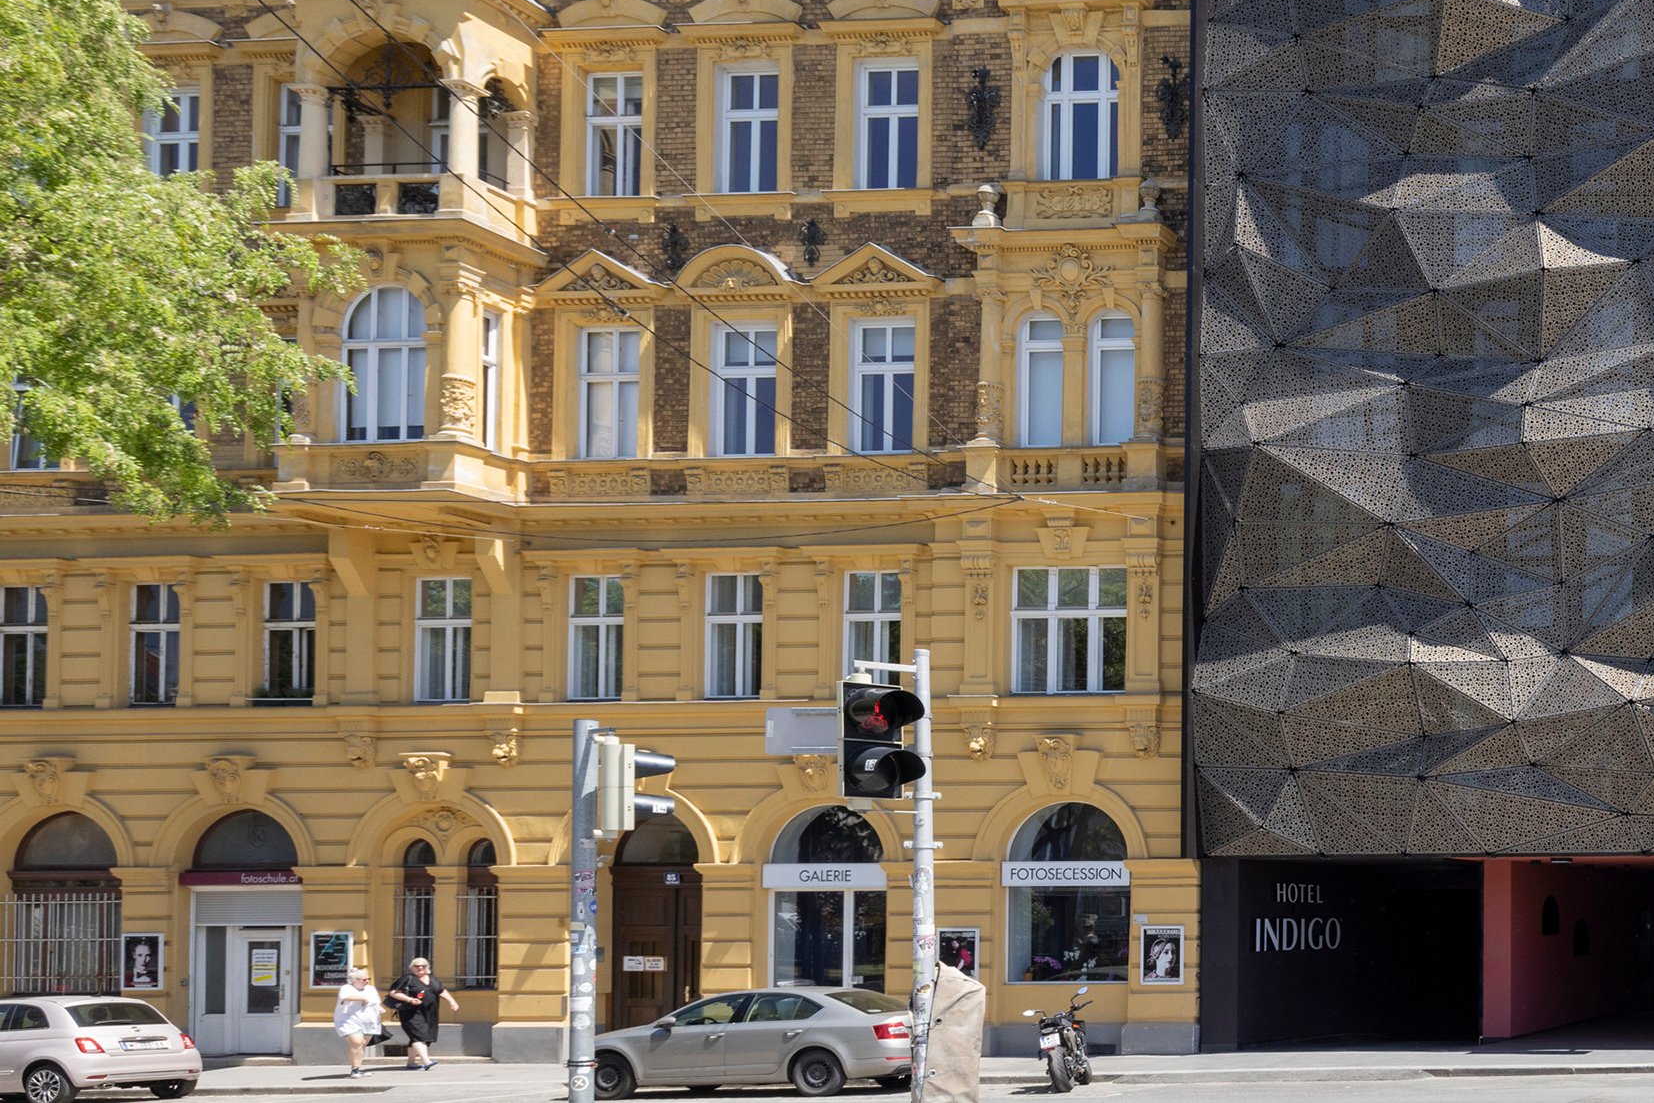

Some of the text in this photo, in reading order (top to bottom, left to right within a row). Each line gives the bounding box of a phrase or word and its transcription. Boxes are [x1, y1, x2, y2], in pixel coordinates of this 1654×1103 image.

[241, 873, 298, 884] fotoschule.at
[799, 870, 851, 882] GALERIE
[1010, 868, 1122, 881] FOTOSECESSION
[1276, 883, 1324, 903] HOTEL
[1255, 917, 1341, 952] INDIGO
